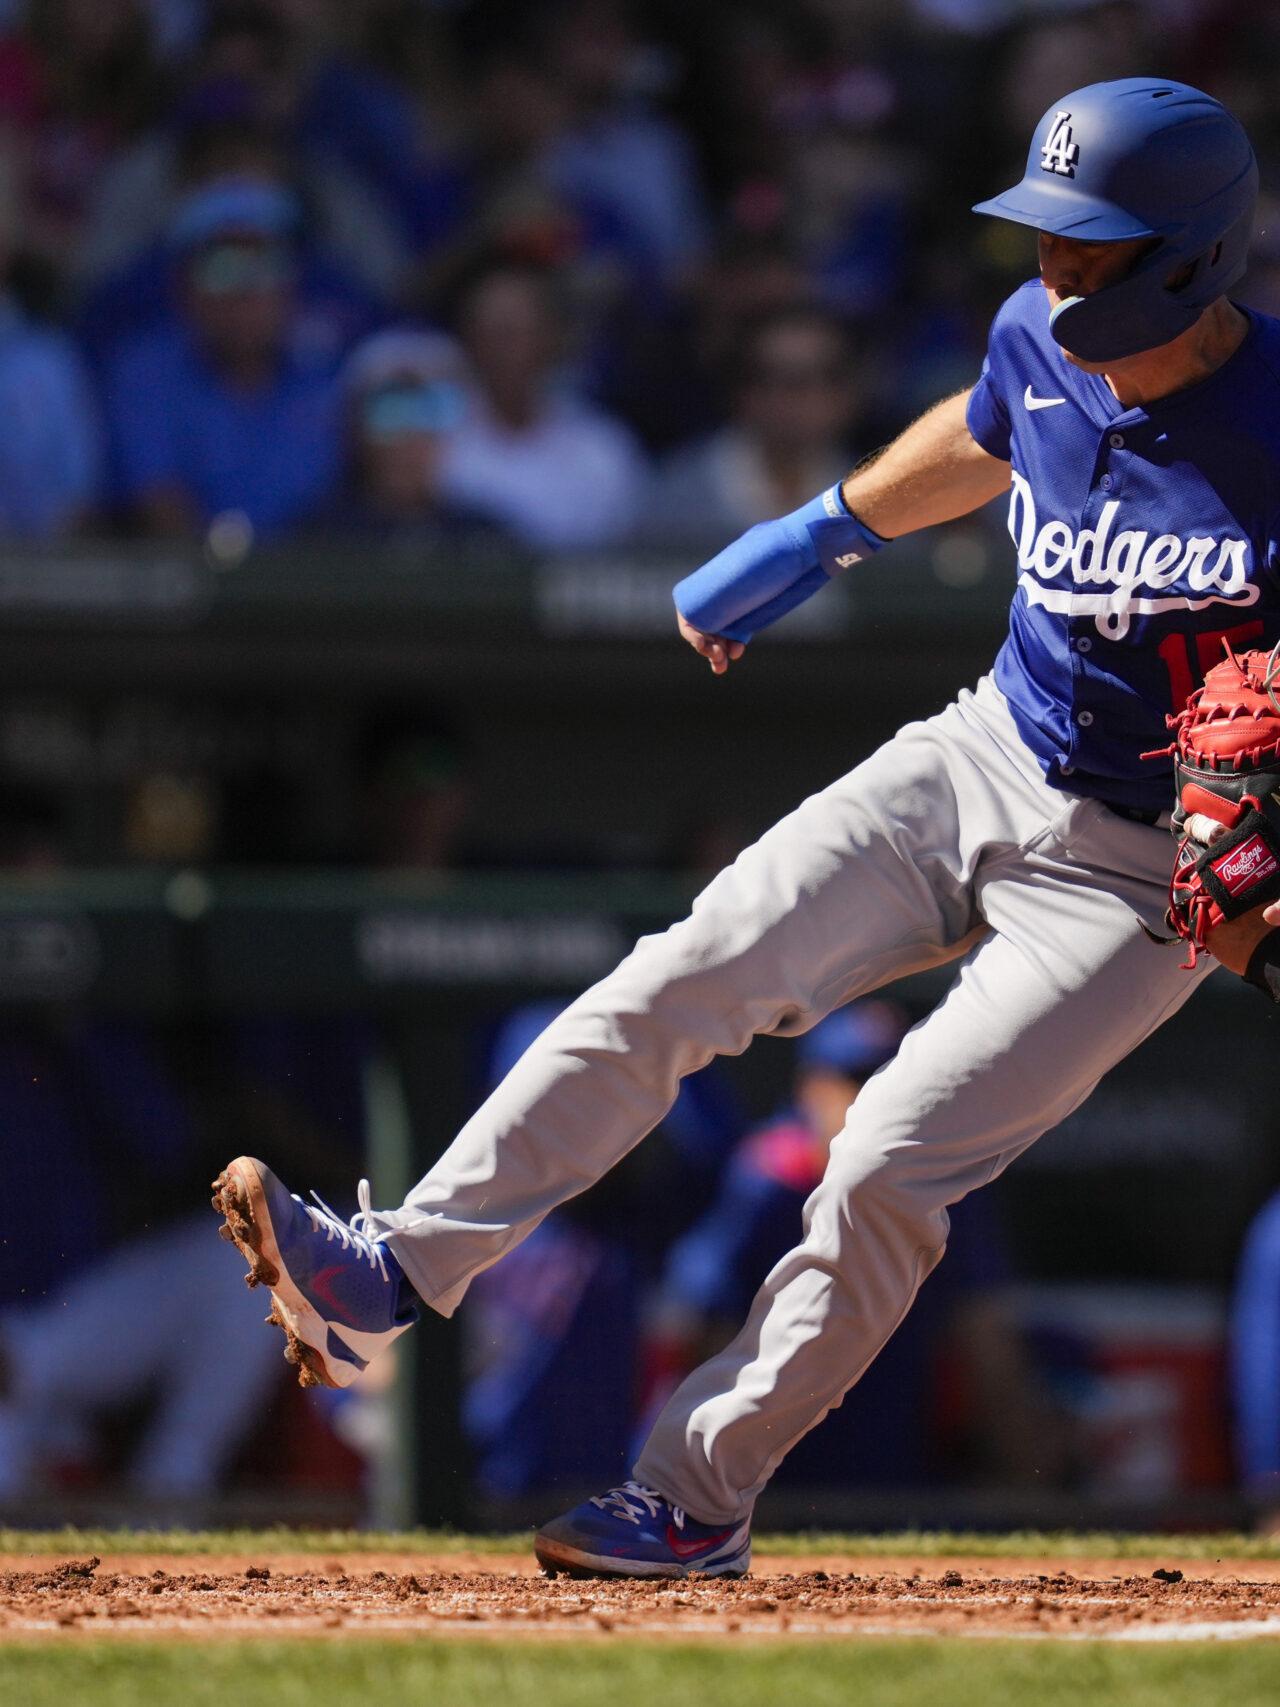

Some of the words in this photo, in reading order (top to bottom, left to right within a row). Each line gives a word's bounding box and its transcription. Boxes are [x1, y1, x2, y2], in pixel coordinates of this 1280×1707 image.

[1040, 110, 1079, 178] LA
[1008, 469, 1261, 641] Dodgers
[1222, 844, 1263, 881] Rawlings
